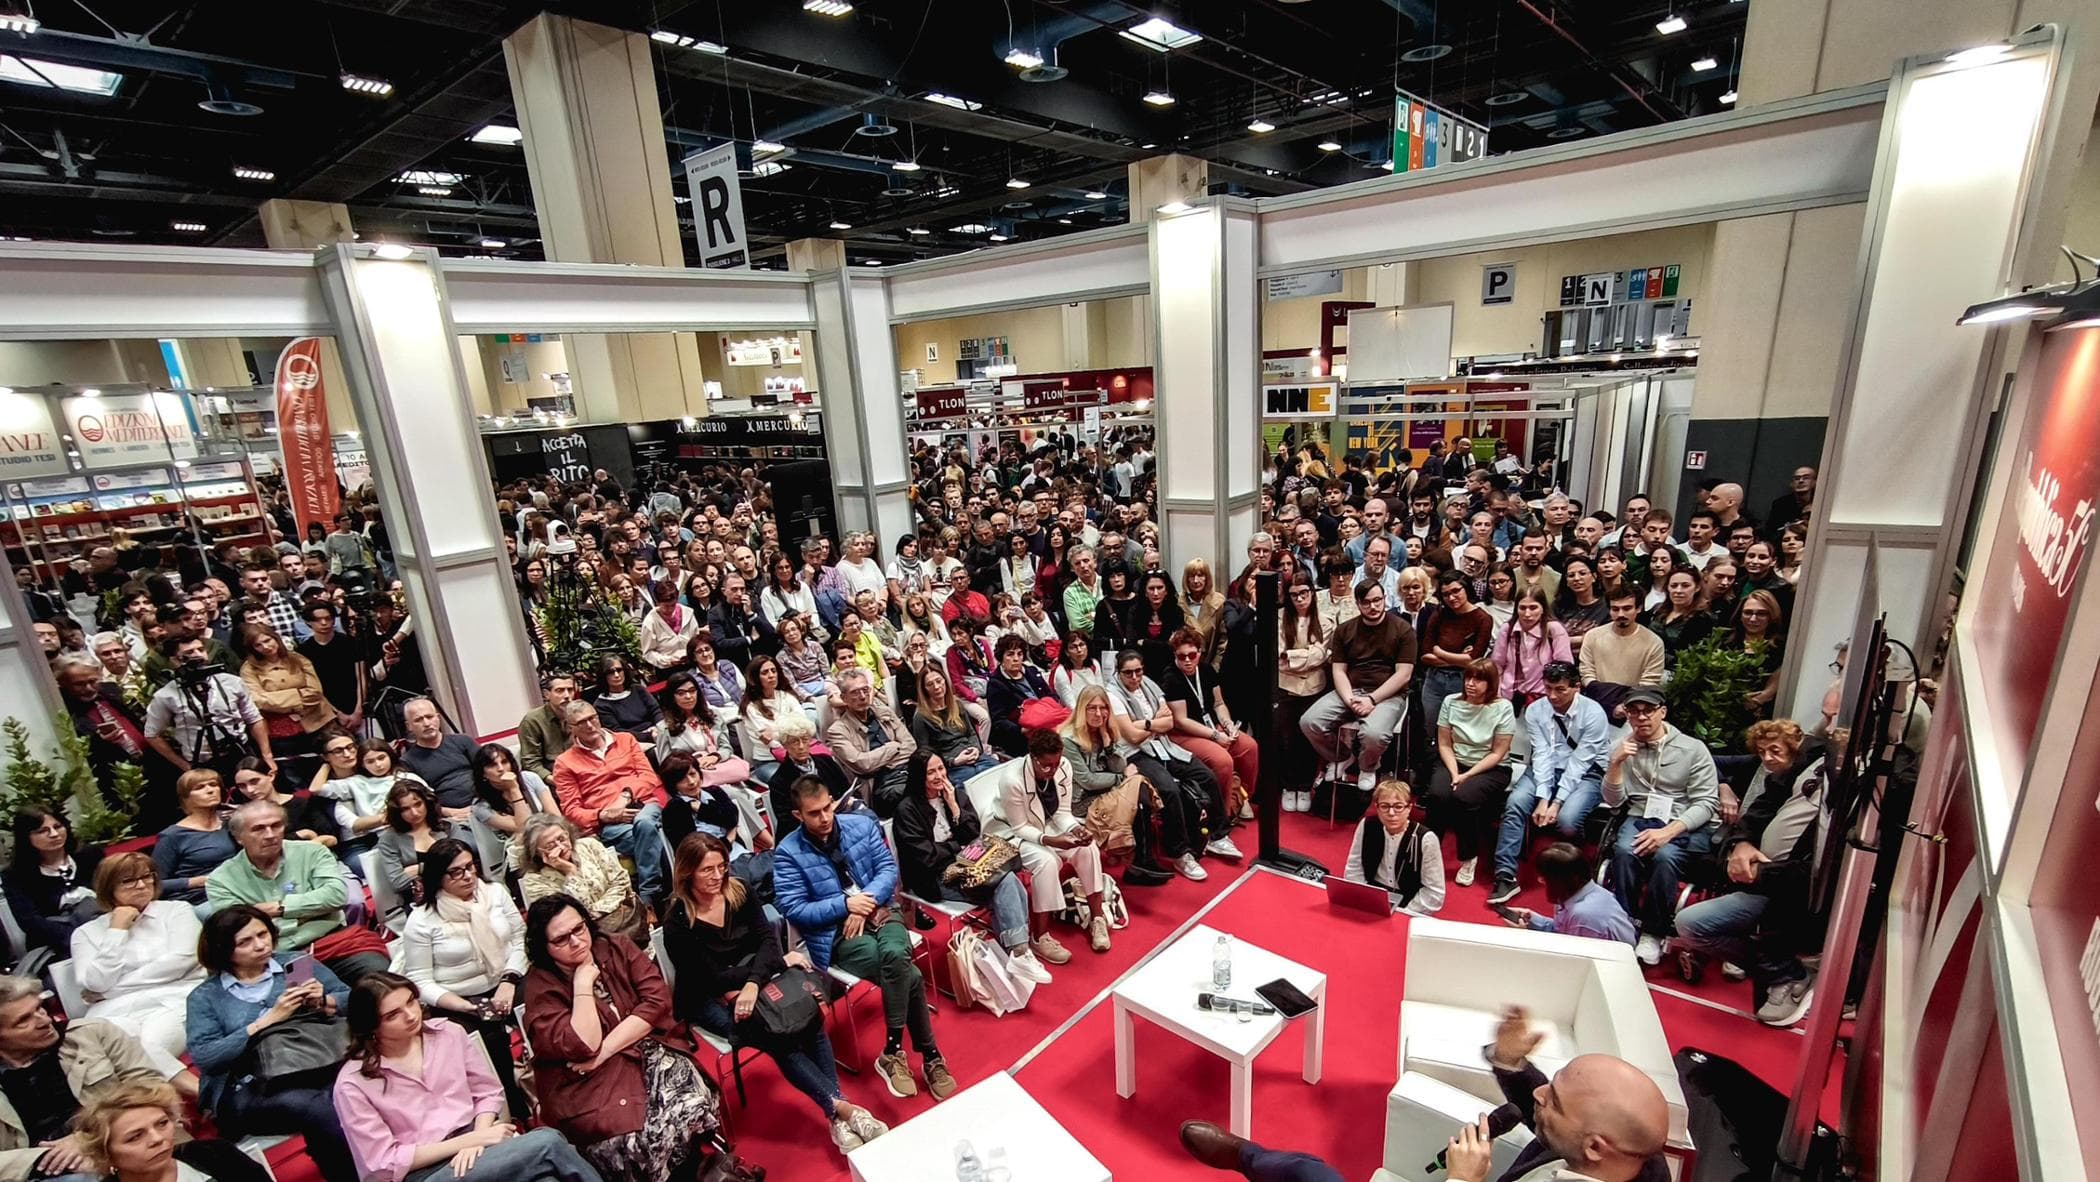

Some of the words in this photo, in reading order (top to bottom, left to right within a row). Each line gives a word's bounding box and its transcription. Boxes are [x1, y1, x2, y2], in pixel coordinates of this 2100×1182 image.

[1466, 130, 1475, 157] 2
[699, 175, 736, 249] R
[1488, 271, 1509, 296] P
[1590, 280, 1607, 301] N
[928, 346, 936, 358] N
[939, 397, 965, 409] TLON
[1042, 390, 1064, 401] TLON
[1267, 387, 1331, 413] NNE
[756, 419, 809, 432] MERCURIO
[542, 432, 587, 453] ACCETTA
[560, 451, 576, 465] IL
